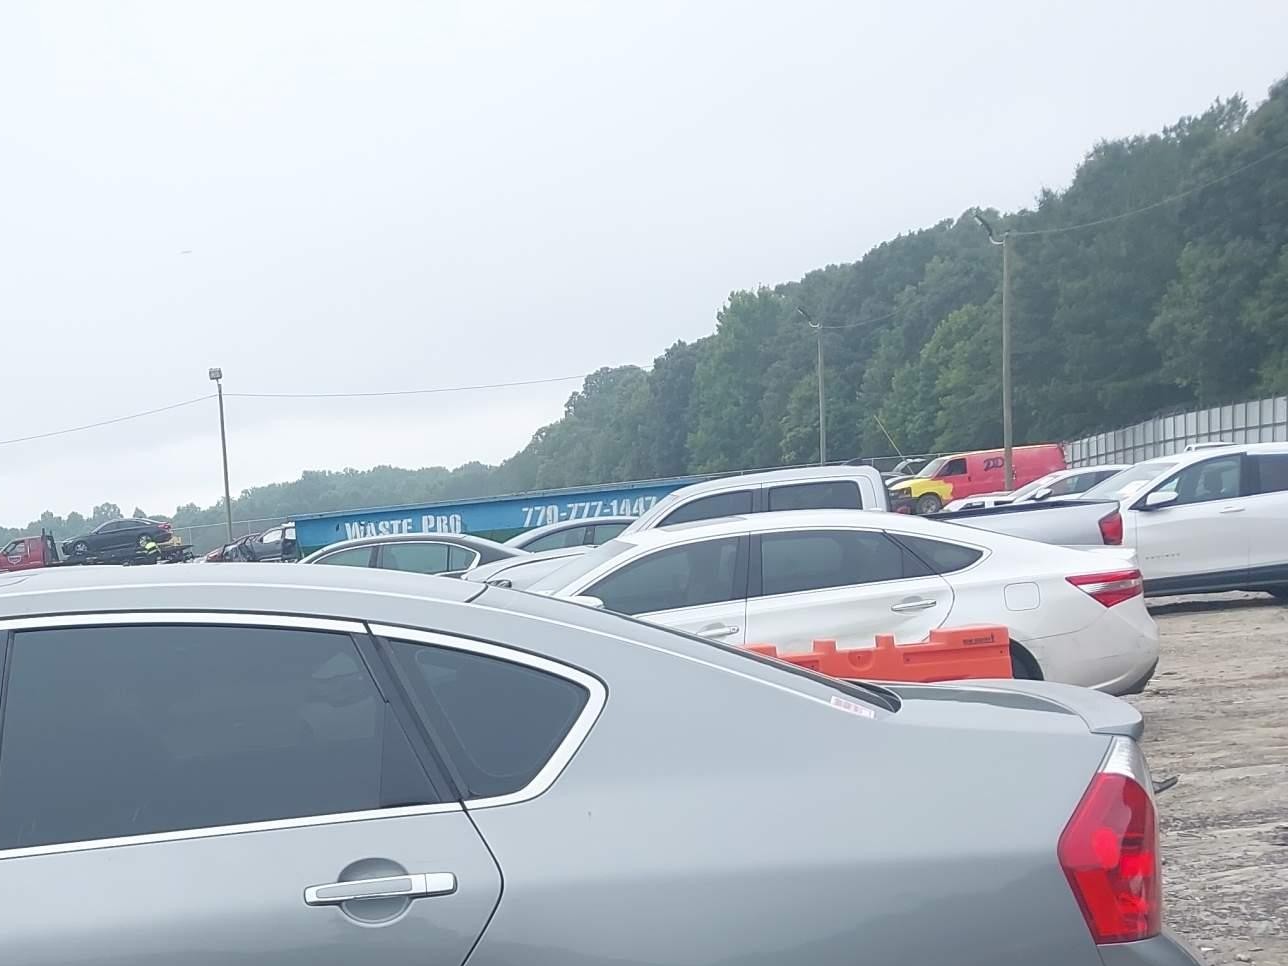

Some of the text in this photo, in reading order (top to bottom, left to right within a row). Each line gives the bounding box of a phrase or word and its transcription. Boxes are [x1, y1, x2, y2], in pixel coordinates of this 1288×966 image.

[522, 496, 658, 528] 770-777-1447
[344, 514, 462, 541] WASTE PRO
